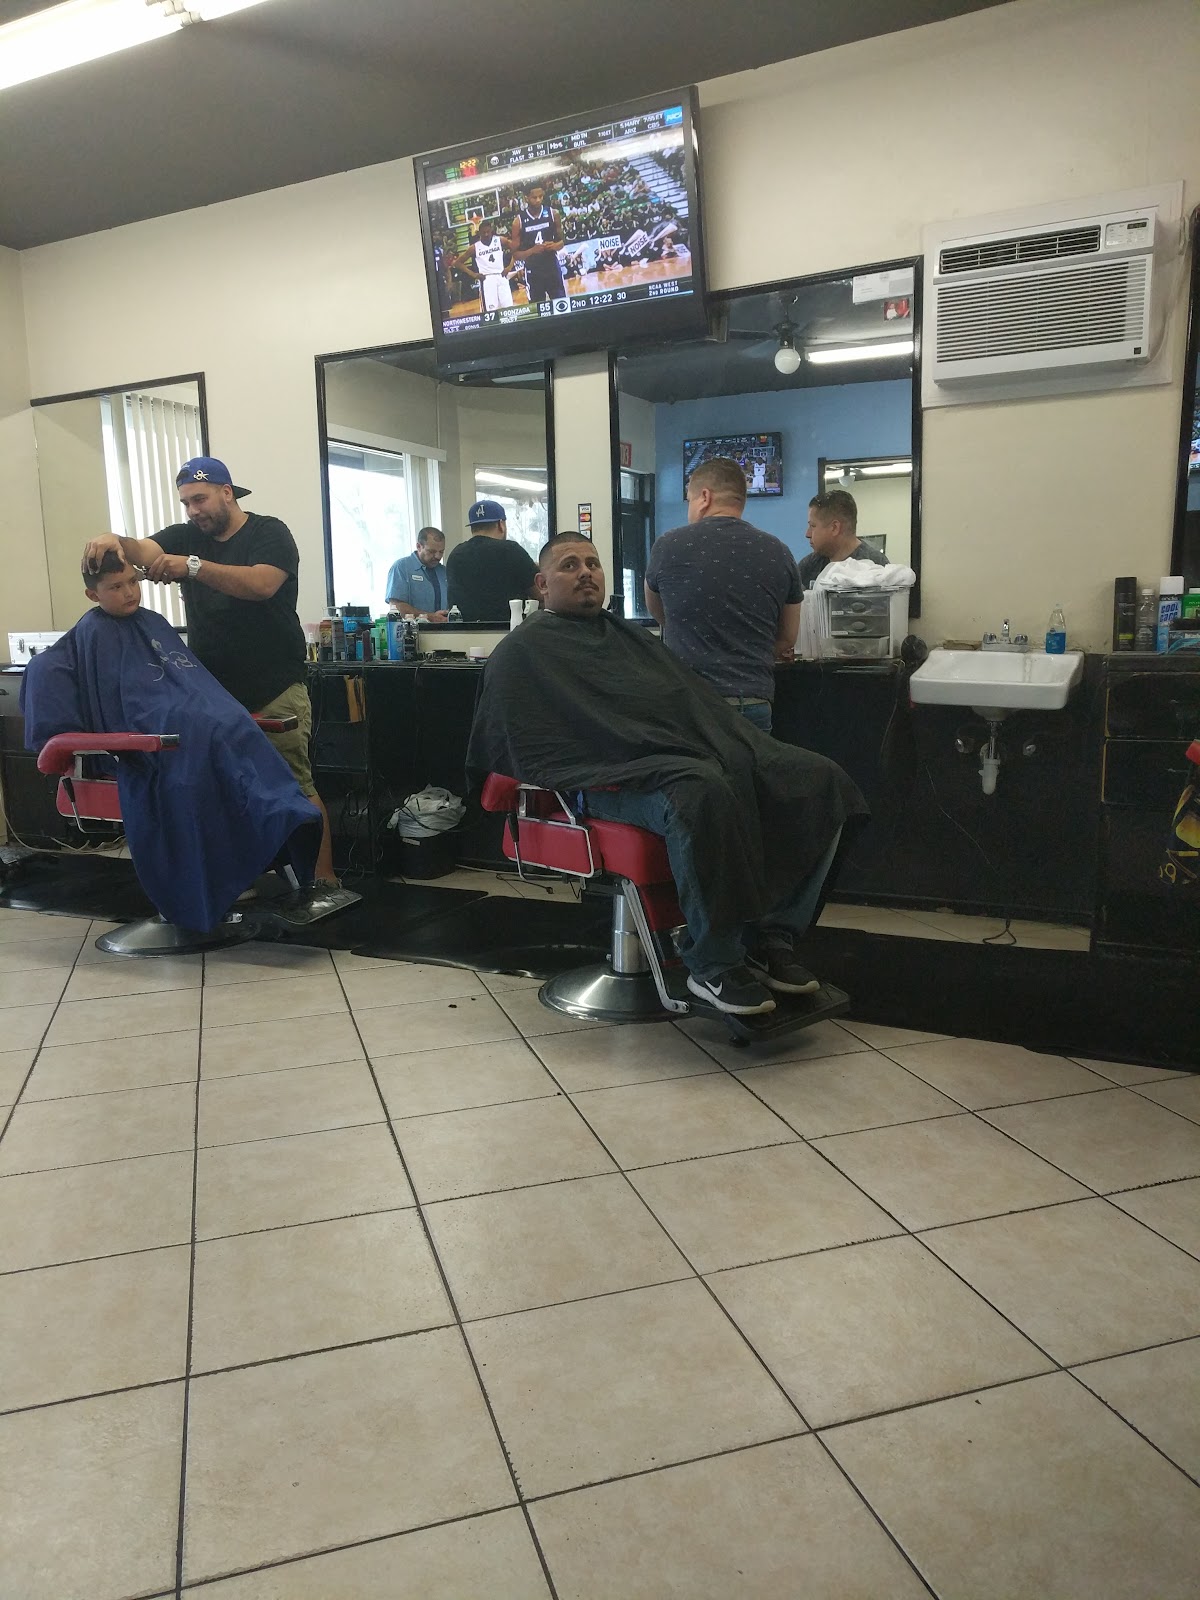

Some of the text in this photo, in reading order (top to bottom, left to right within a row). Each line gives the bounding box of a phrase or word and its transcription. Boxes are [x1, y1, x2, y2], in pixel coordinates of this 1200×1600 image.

[535, 231, 543, 244] 4
[600, 237, 619, 249] NOISE
[629, 234, 648, 254] NOISE
[488, 254, 495, 263] 4
[663, 280, 678, 288] WEST
[660, 286, 679, 295] ROUND
[571, 291, 627, 309] 2ND 12:22 30
[540, 303, 551, 312] 55
[484, 312, 495, 322] 37
